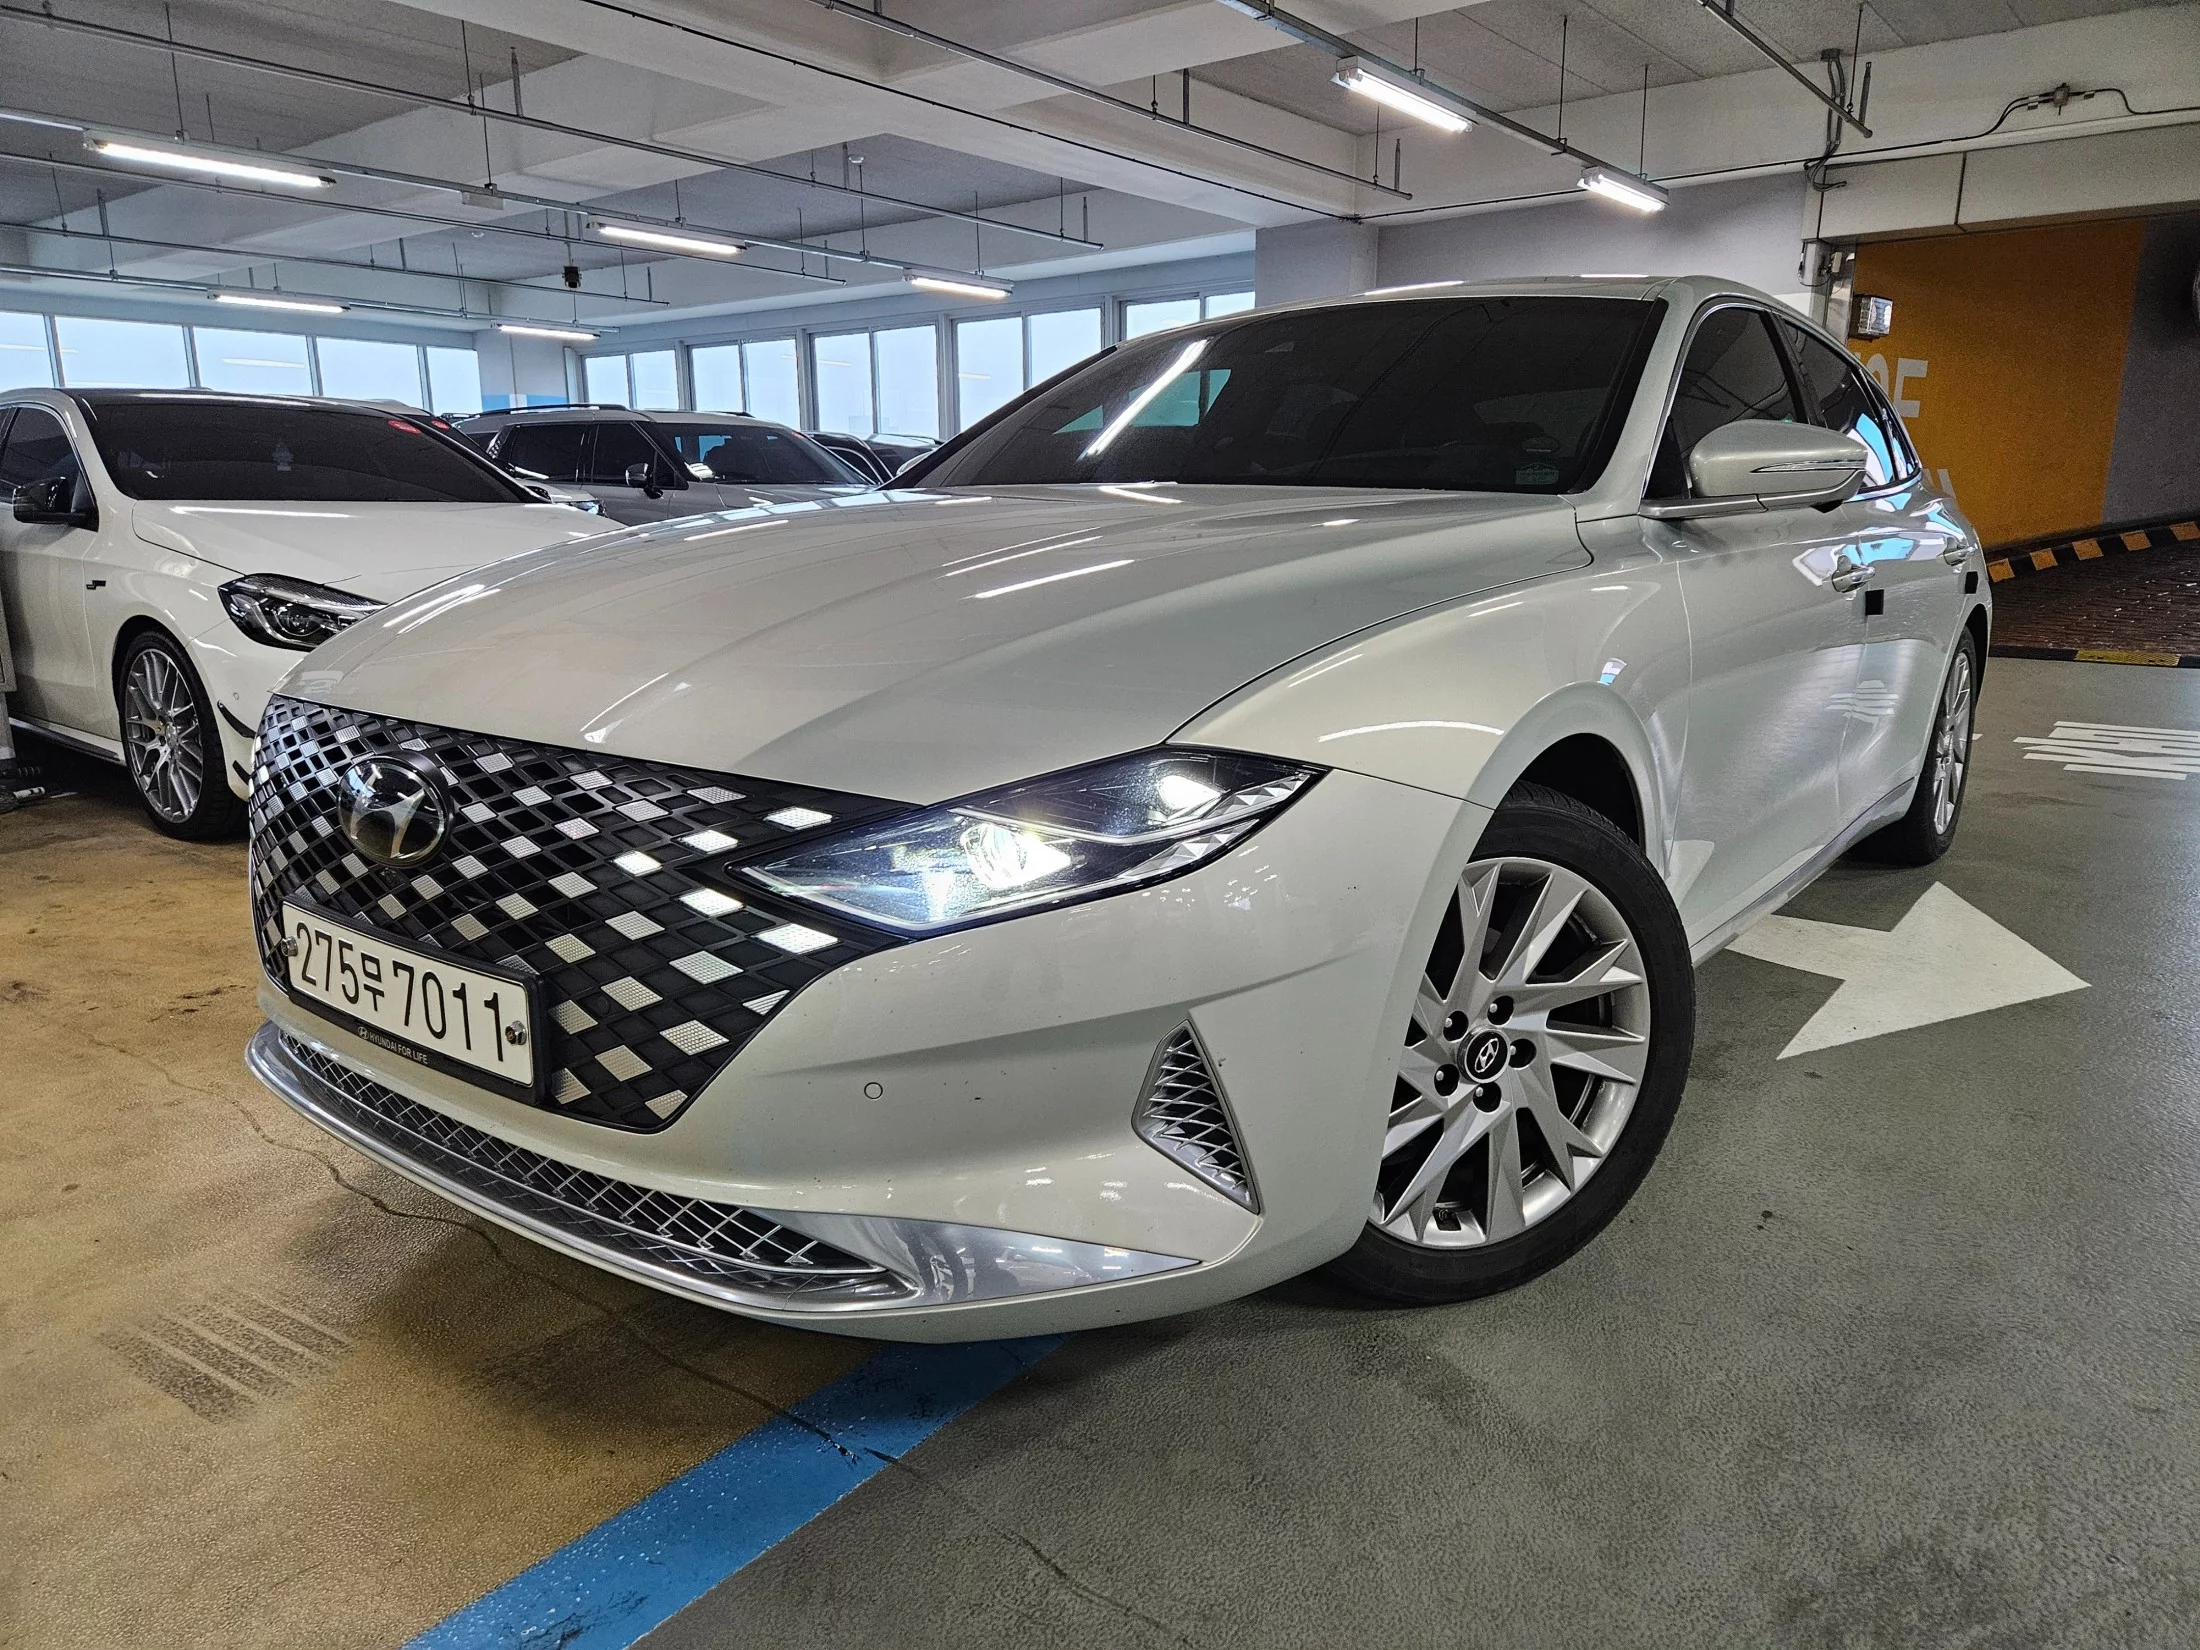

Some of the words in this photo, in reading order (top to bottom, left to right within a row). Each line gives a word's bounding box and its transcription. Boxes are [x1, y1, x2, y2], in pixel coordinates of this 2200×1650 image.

[296, 921, 504, 1063] 275무7011
[369, 1032, 397, 1051] HYUNDAI
[398, 1044, 412, 1058] FOR
[412, 1050, 428, 1064] LIFE
